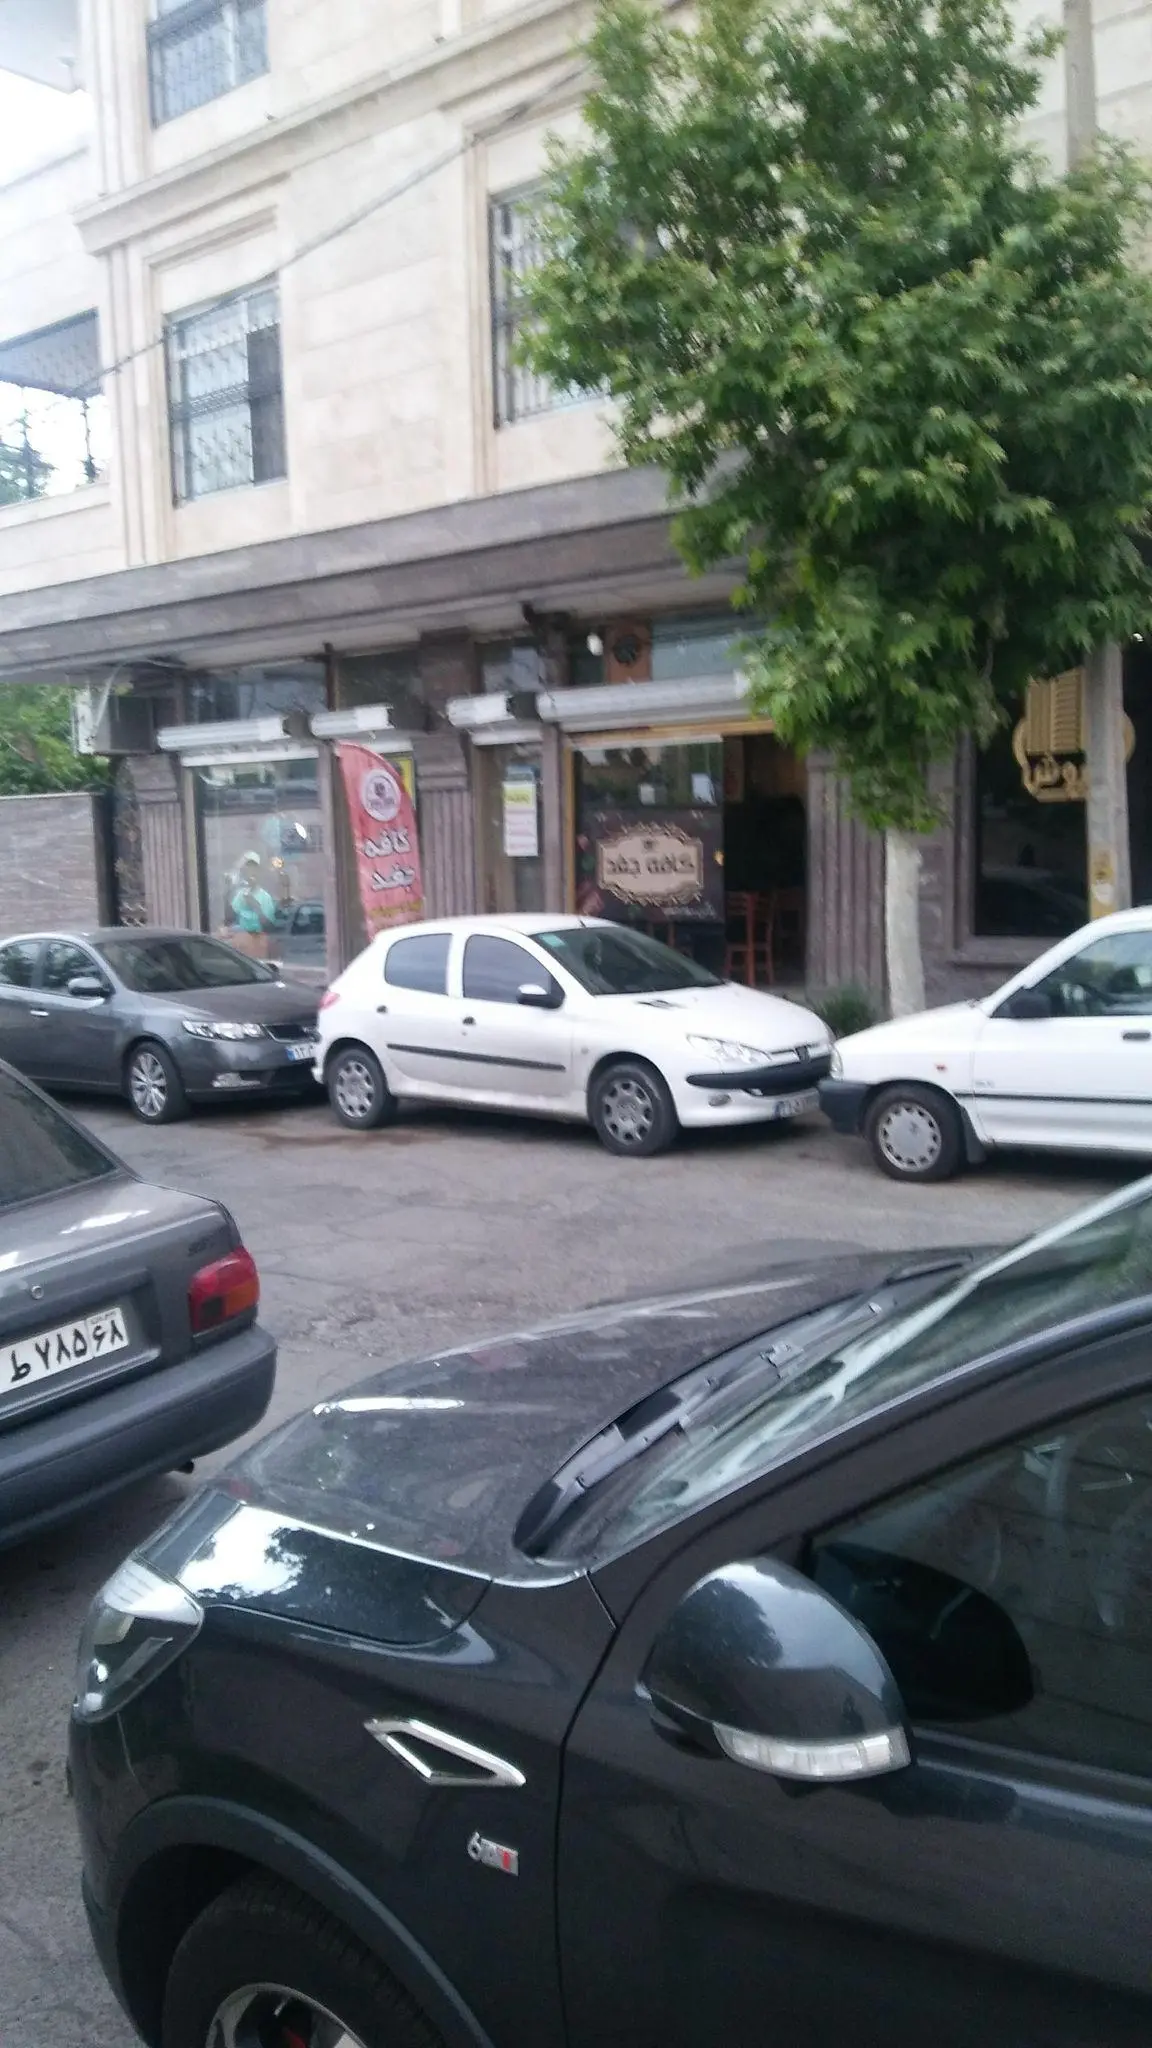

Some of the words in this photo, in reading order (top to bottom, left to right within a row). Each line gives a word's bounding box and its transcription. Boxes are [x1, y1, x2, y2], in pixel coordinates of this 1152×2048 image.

[364, 827, 412, 858] کافه
[371, 862, 416, 893] جغد
[645, 852, 695, 874] کافه
